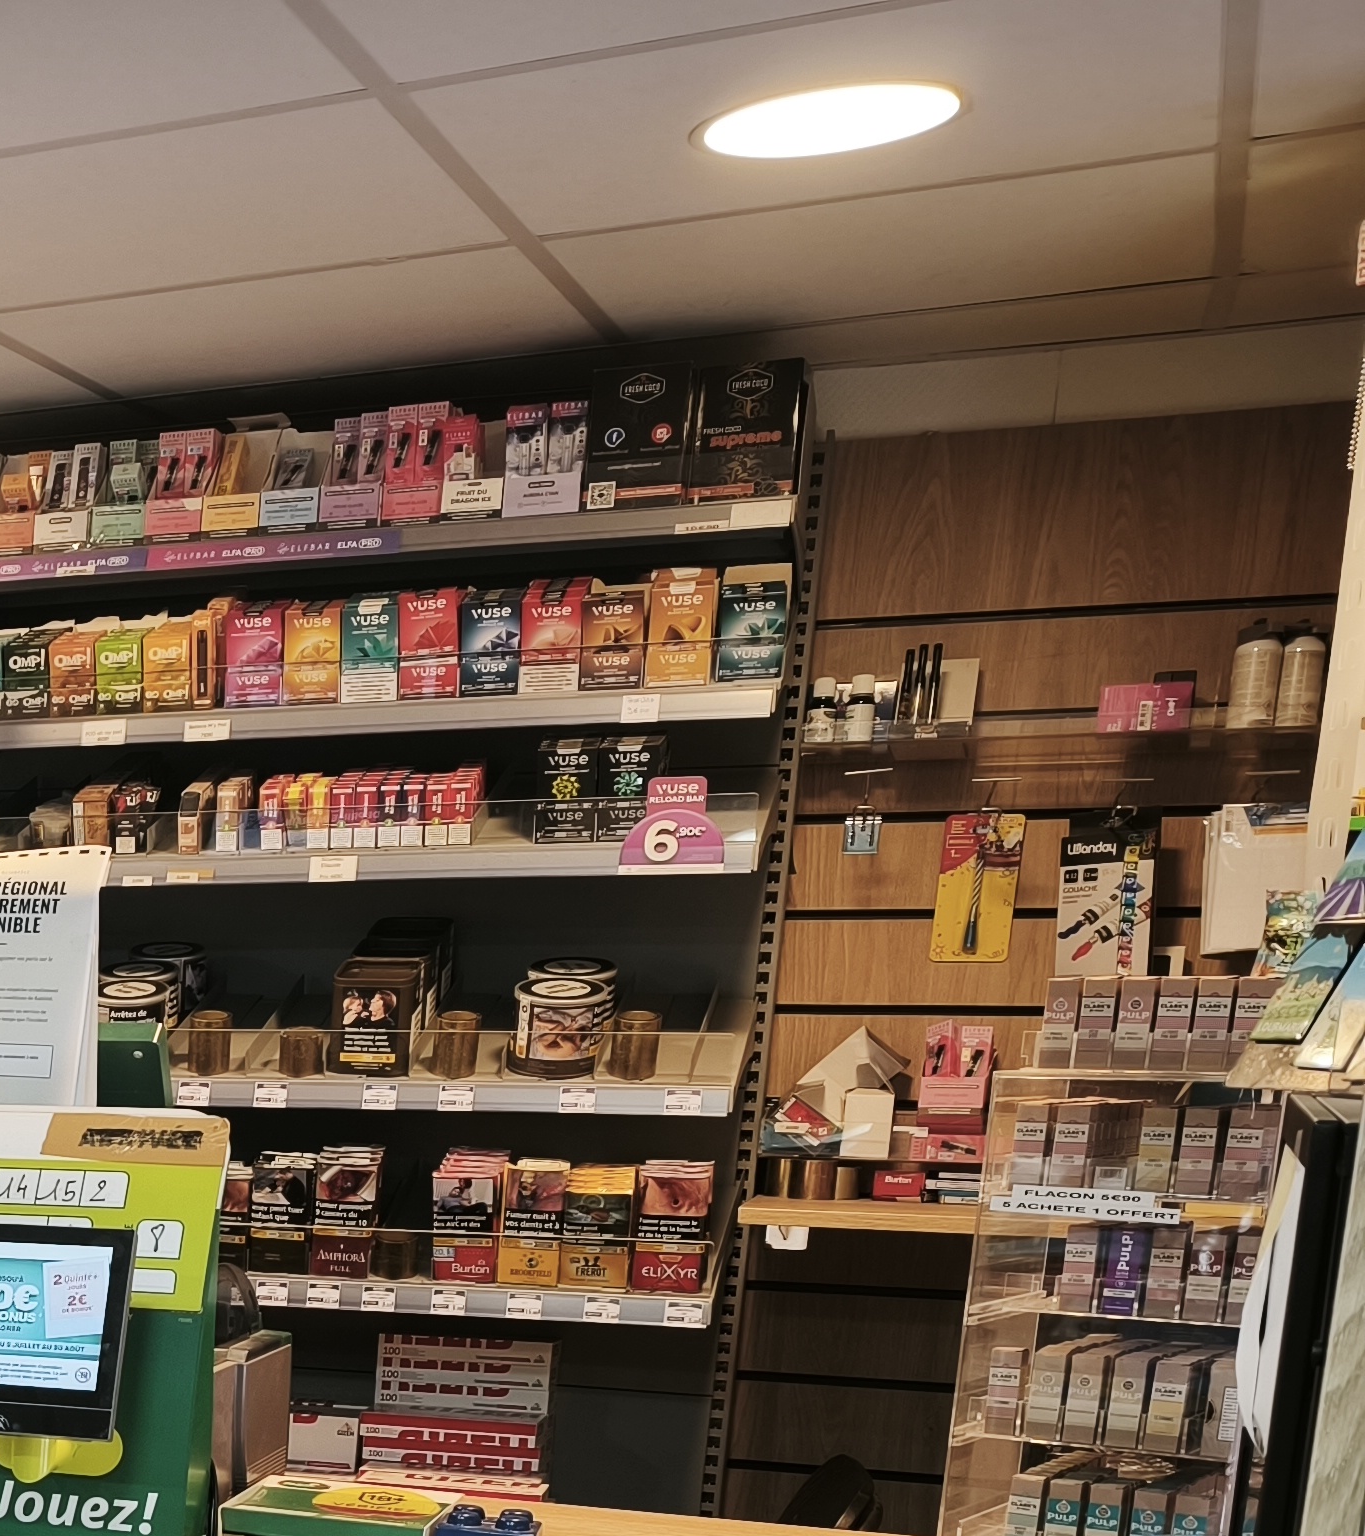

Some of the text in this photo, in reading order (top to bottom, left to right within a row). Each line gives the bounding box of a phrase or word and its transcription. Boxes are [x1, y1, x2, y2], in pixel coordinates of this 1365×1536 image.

[709, 429, 782, 449] supreme
[337, 540, 357, 550] ELFA
[649, 794, 705, 804] RELOAD BAR
[1024, 1189, 1141, 1202] FLACON 5€90
[1016, 1203, 1086, 1214] ACHETE
[1107, 1209, 1177, 1219] OFFERT
[315, 1252, 366, 1263] AMPHORA
[451, 1263, 489, 1275] Burton
[1047, 1512, 1077, 1522] PULP
[1087, 1517, 1117, 1528] PULP
